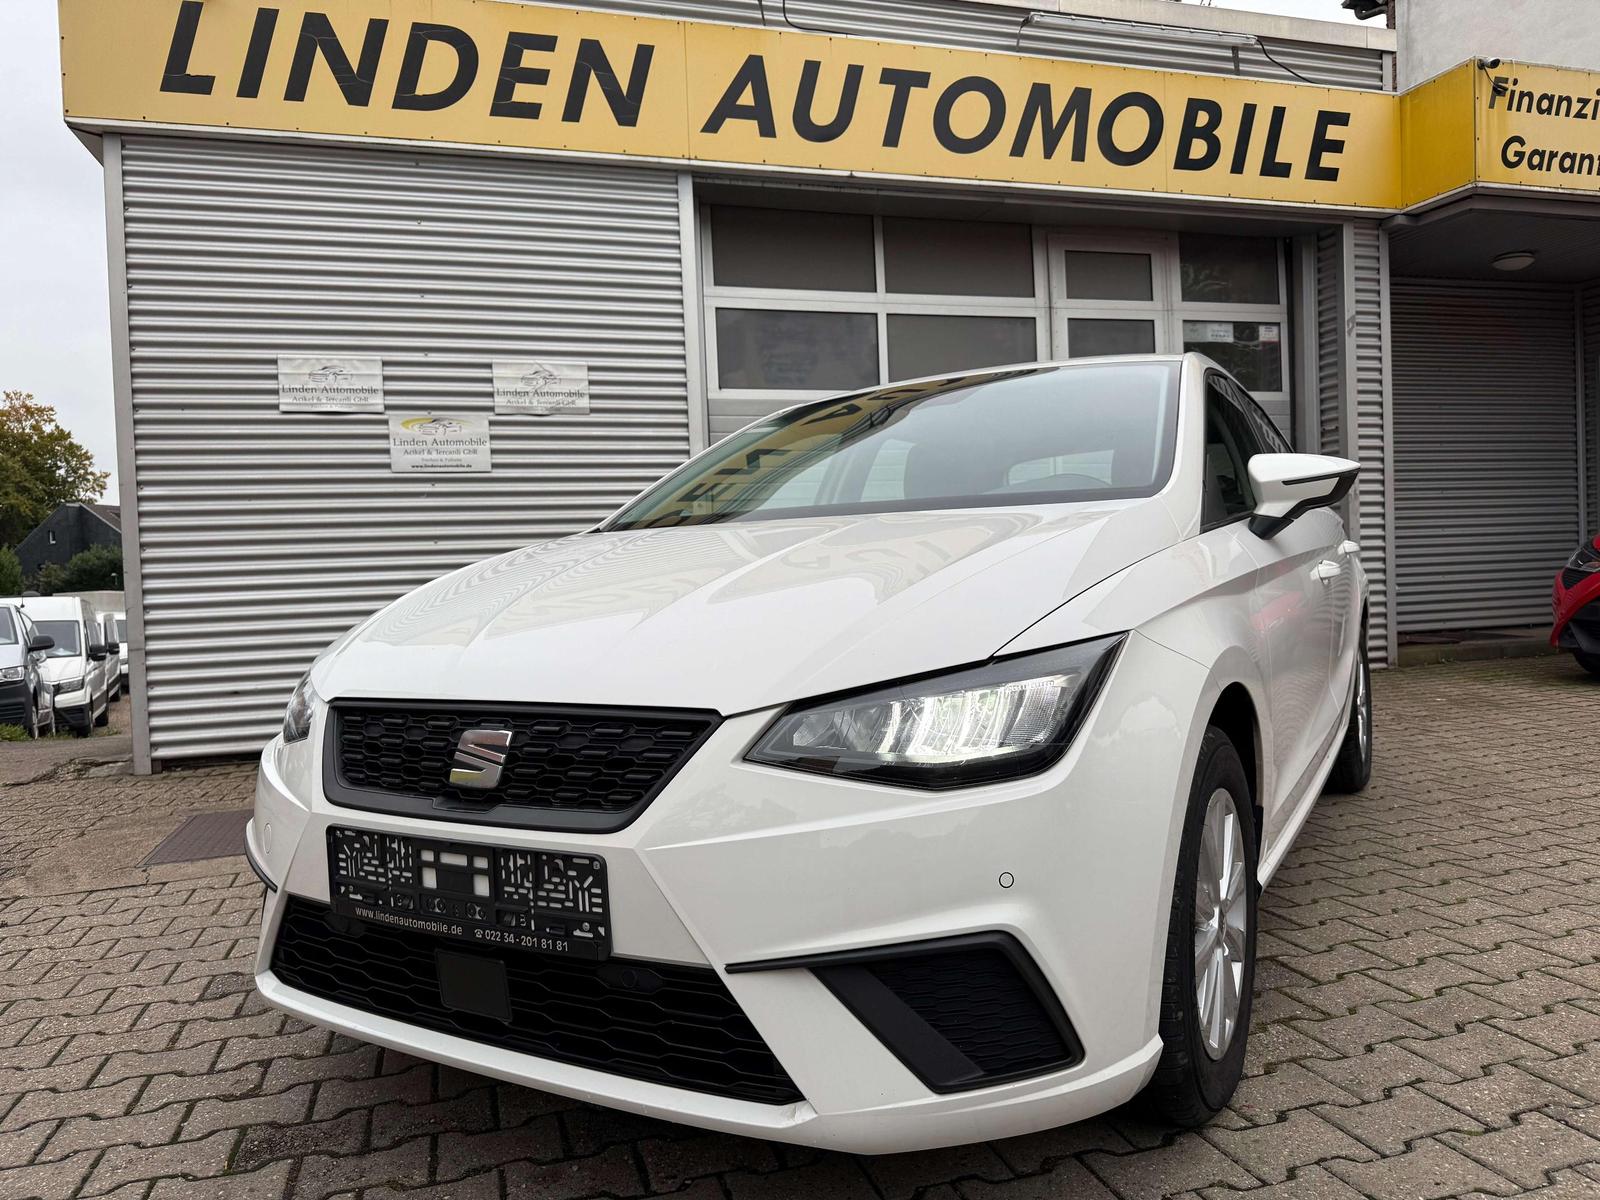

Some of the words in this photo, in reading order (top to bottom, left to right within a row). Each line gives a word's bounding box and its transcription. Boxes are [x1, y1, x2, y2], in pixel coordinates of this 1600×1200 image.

[159, 0, 655, 127] LINDEN
[700, 54, 1351, 182] AUTOMOBILE
[1488, 75, 1600, 121] Finanzi
[282, 384, 317, 393] Linden
[321, 385, 379, 395] Automobile
[496, 388, 529, 397] Linden
[533, 388, 585, 398] Automobile
[393, 438, 427, 446] Linden
[431, 438, 487, 447] Automobile
[355, 906, 463, 935] www.lindenautomobile.de
[485, 930, 501, 942] 022
[541, 938, 553, 949] 81
[556, 940, 569, 951] 81
